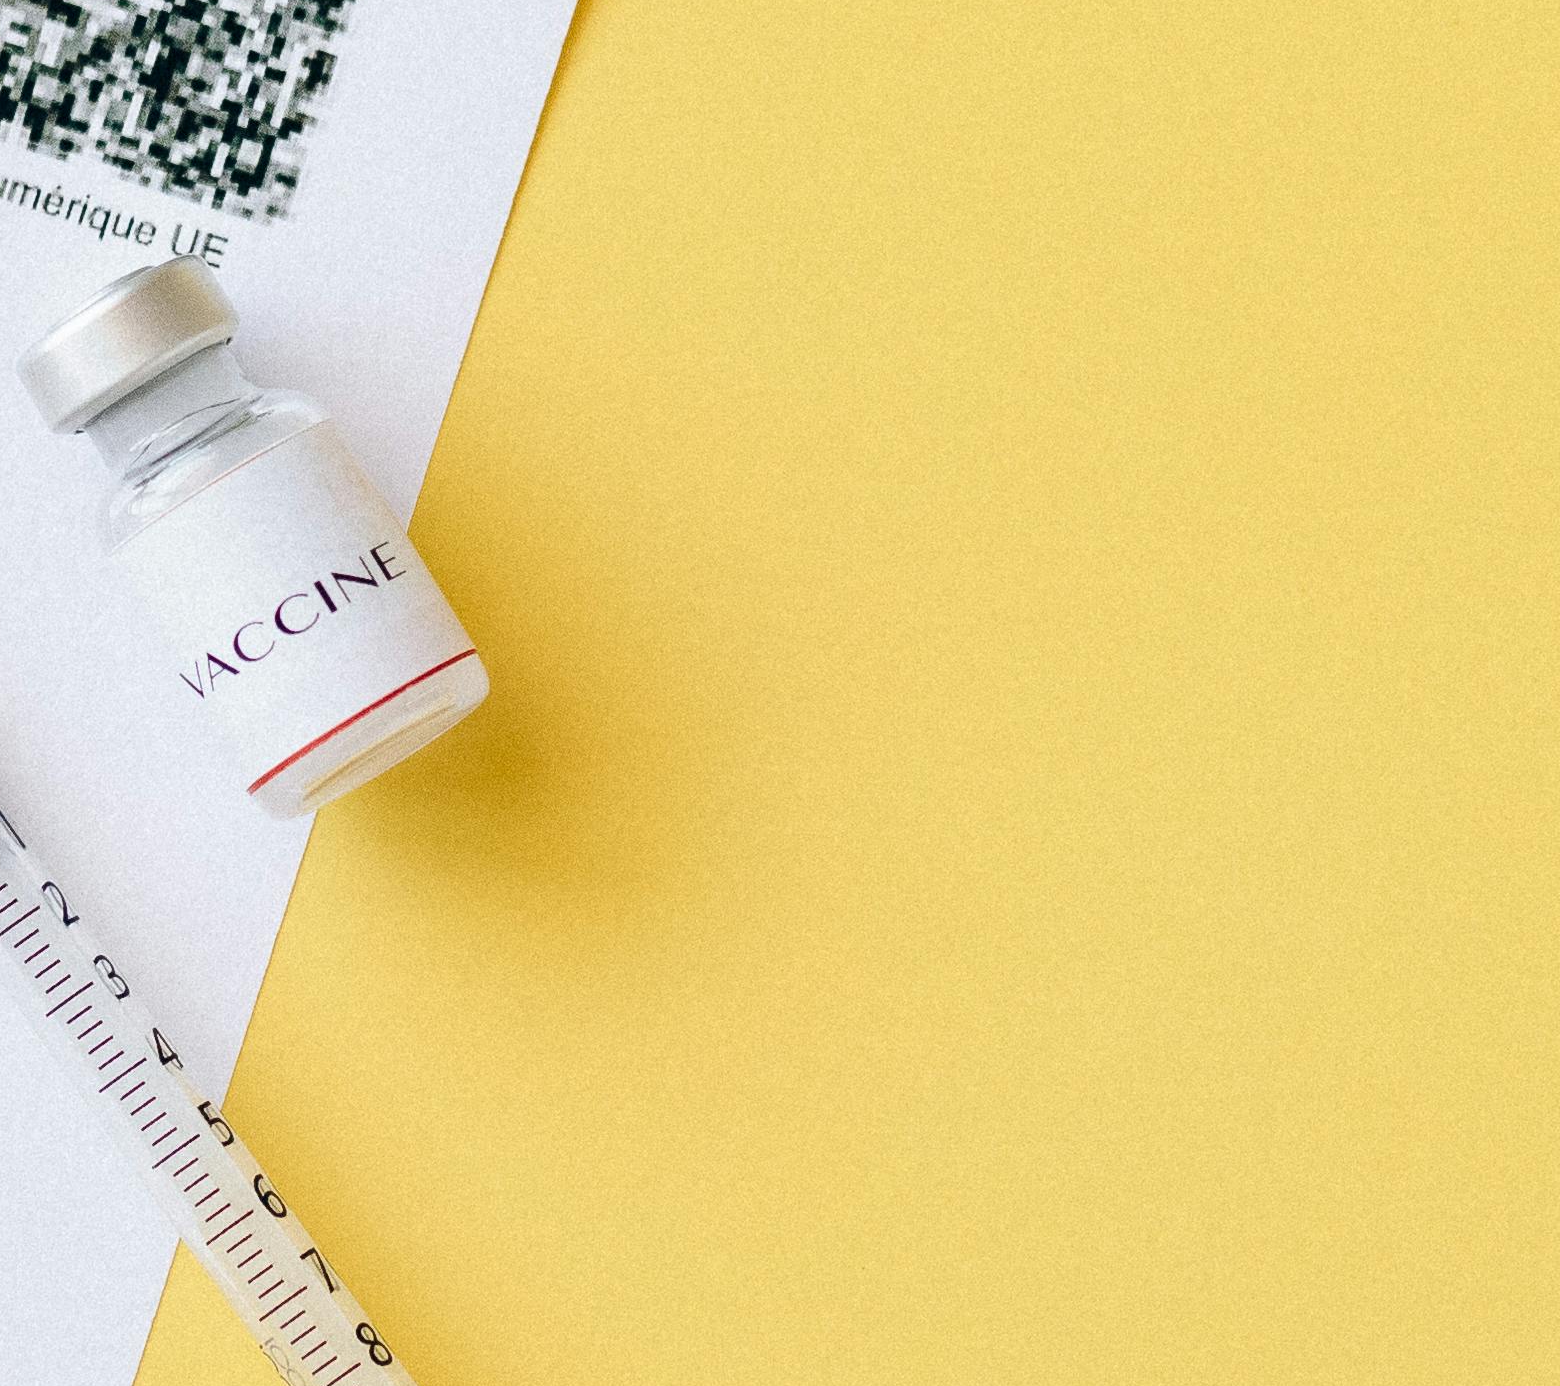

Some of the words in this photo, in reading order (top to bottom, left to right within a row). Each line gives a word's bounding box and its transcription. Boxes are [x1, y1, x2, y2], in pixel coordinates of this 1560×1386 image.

[177, 538, 408, 700] VACCINE
[41, 880, 80, 928] 2
[92, 953, 131, 1001] 3
[150, 1026, 185, 1071] 4
[196, 1099, 236, 1148] 5
[252, 1172, 289, 1220] 6
[298, 1246, 341, 1294] 7
[354, 1321, 394, 1367] 8
